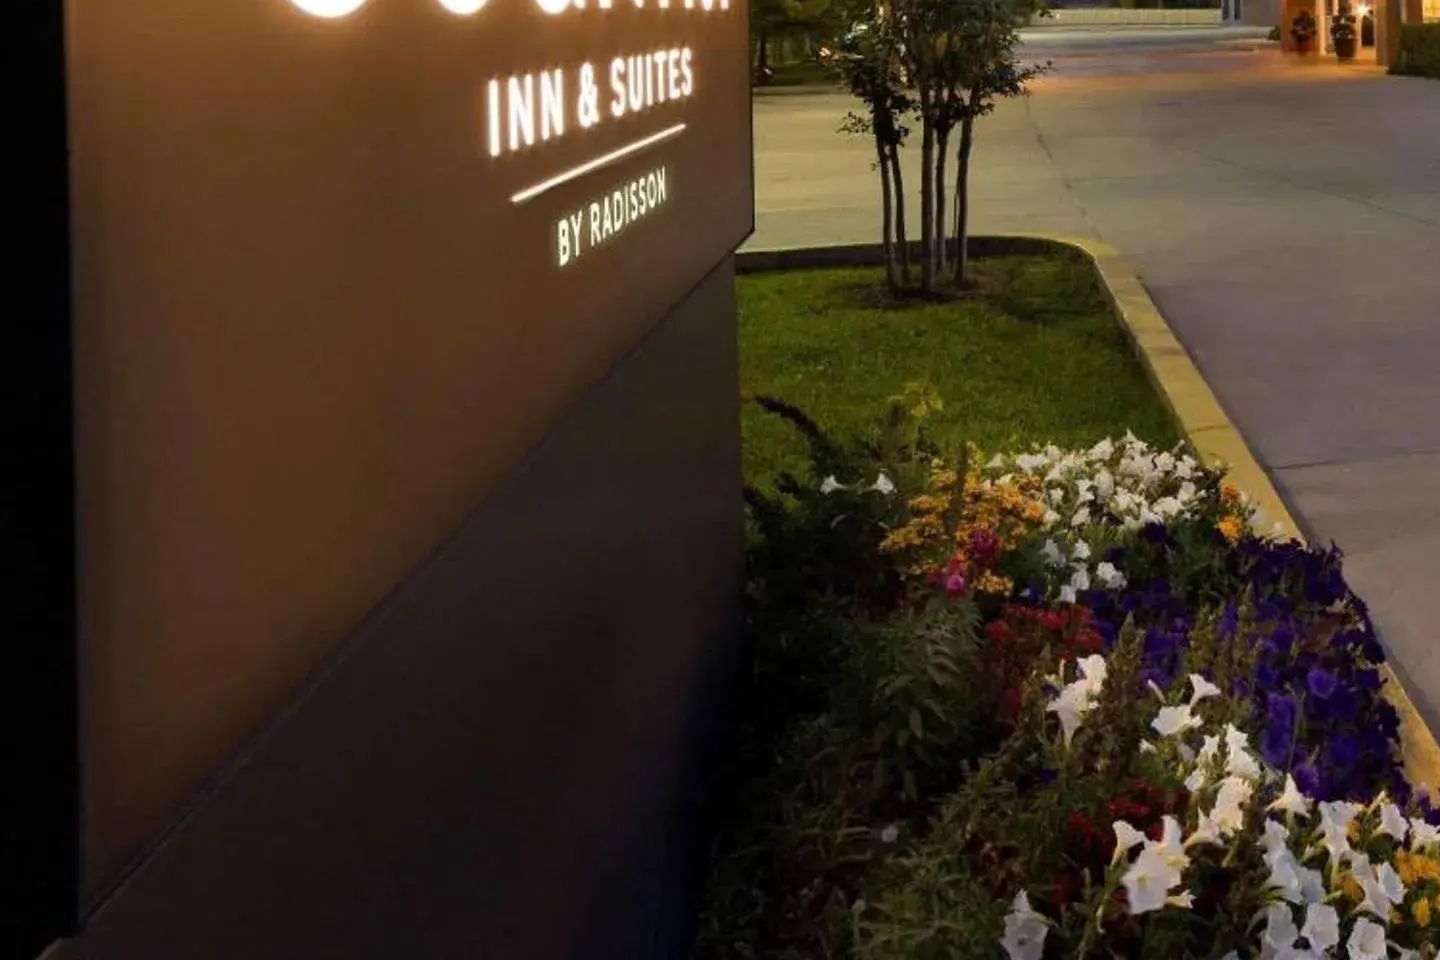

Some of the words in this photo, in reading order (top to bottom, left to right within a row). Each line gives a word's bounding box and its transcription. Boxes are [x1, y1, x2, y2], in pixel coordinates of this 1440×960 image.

[487, 68, 566, 157] INN
[577, 62, 601, 128] &
[610, 46, 694, 118] SUITES
[557, 211, 583, 267] BY
[589, 167, 668, 245] RADISSON
